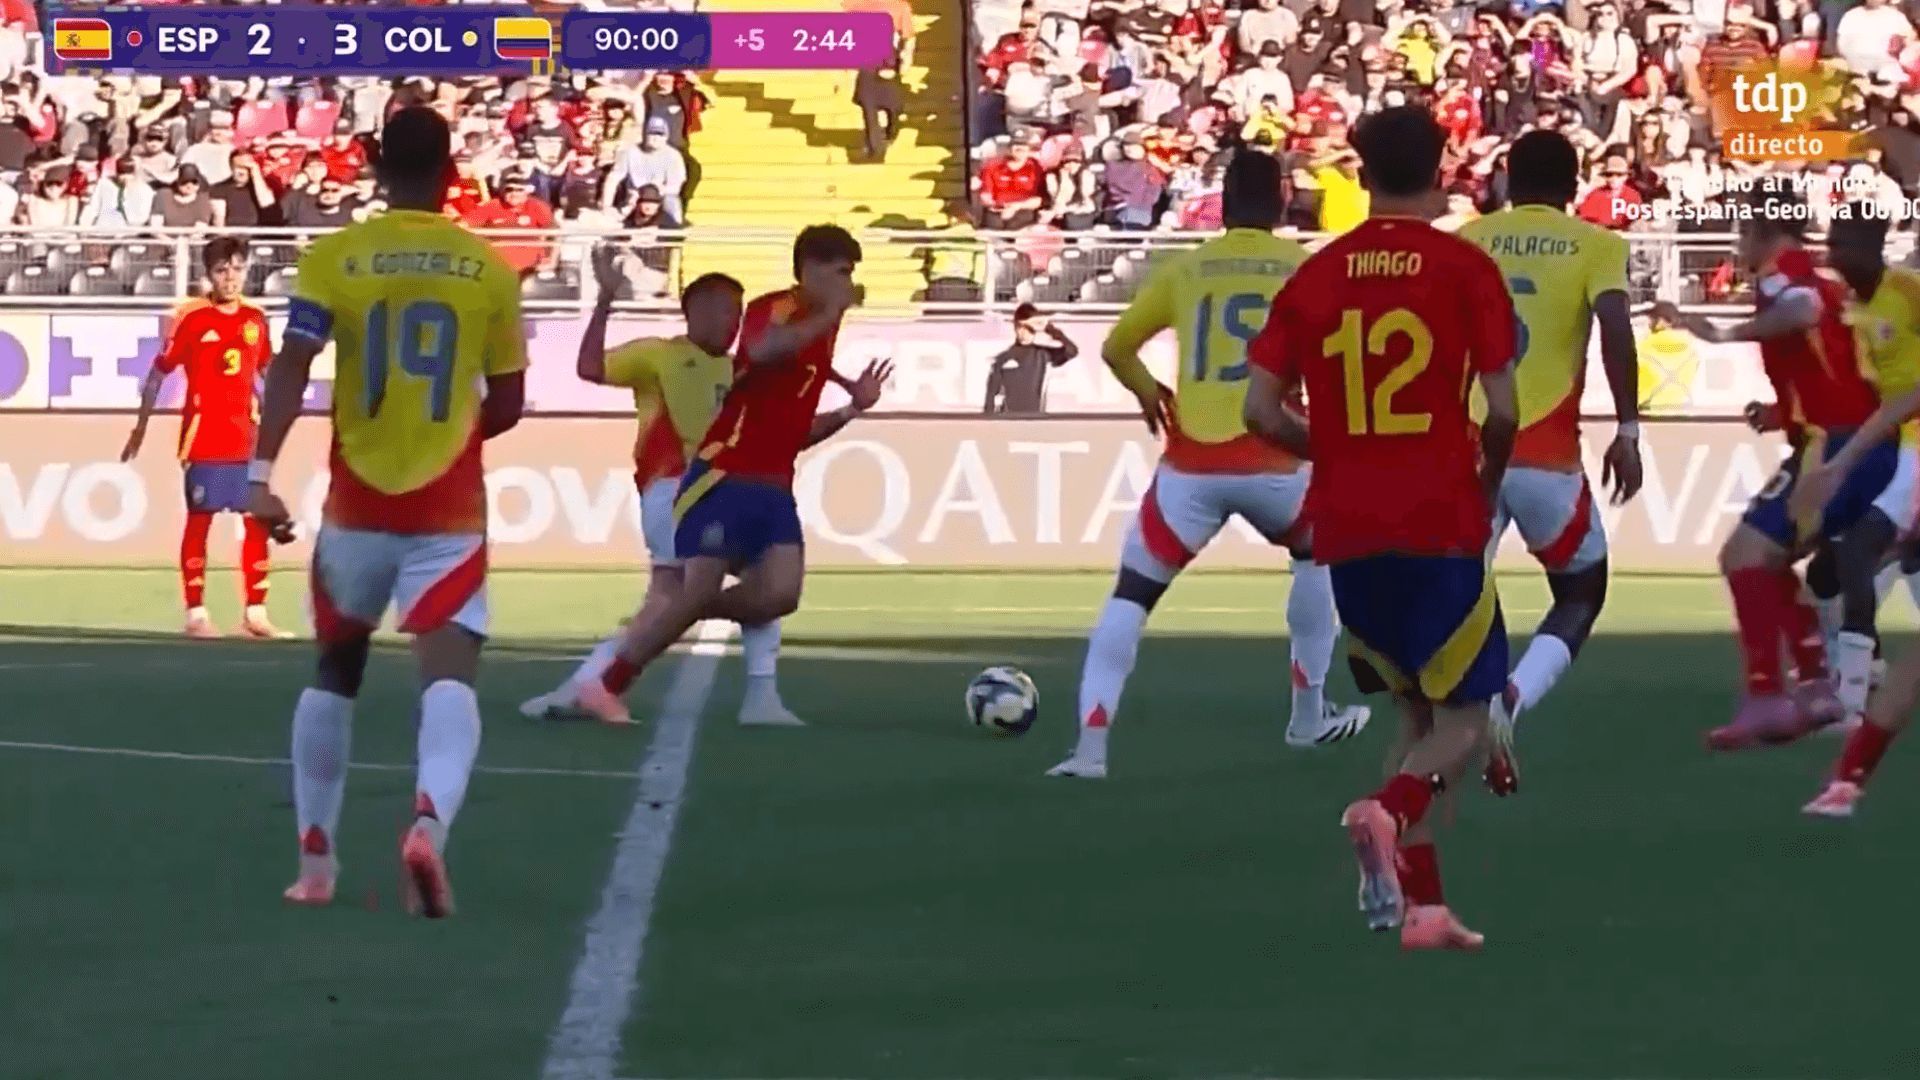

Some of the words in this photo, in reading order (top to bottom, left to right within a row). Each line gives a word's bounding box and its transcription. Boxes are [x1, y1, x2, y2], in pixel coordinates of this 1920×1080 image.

[1345, 250, 1422, 278] THIAGO
[223, 348, 242, 376] 3
[366, 298, 459, 422] 19
[1322, 308, 1434, 435] 12
